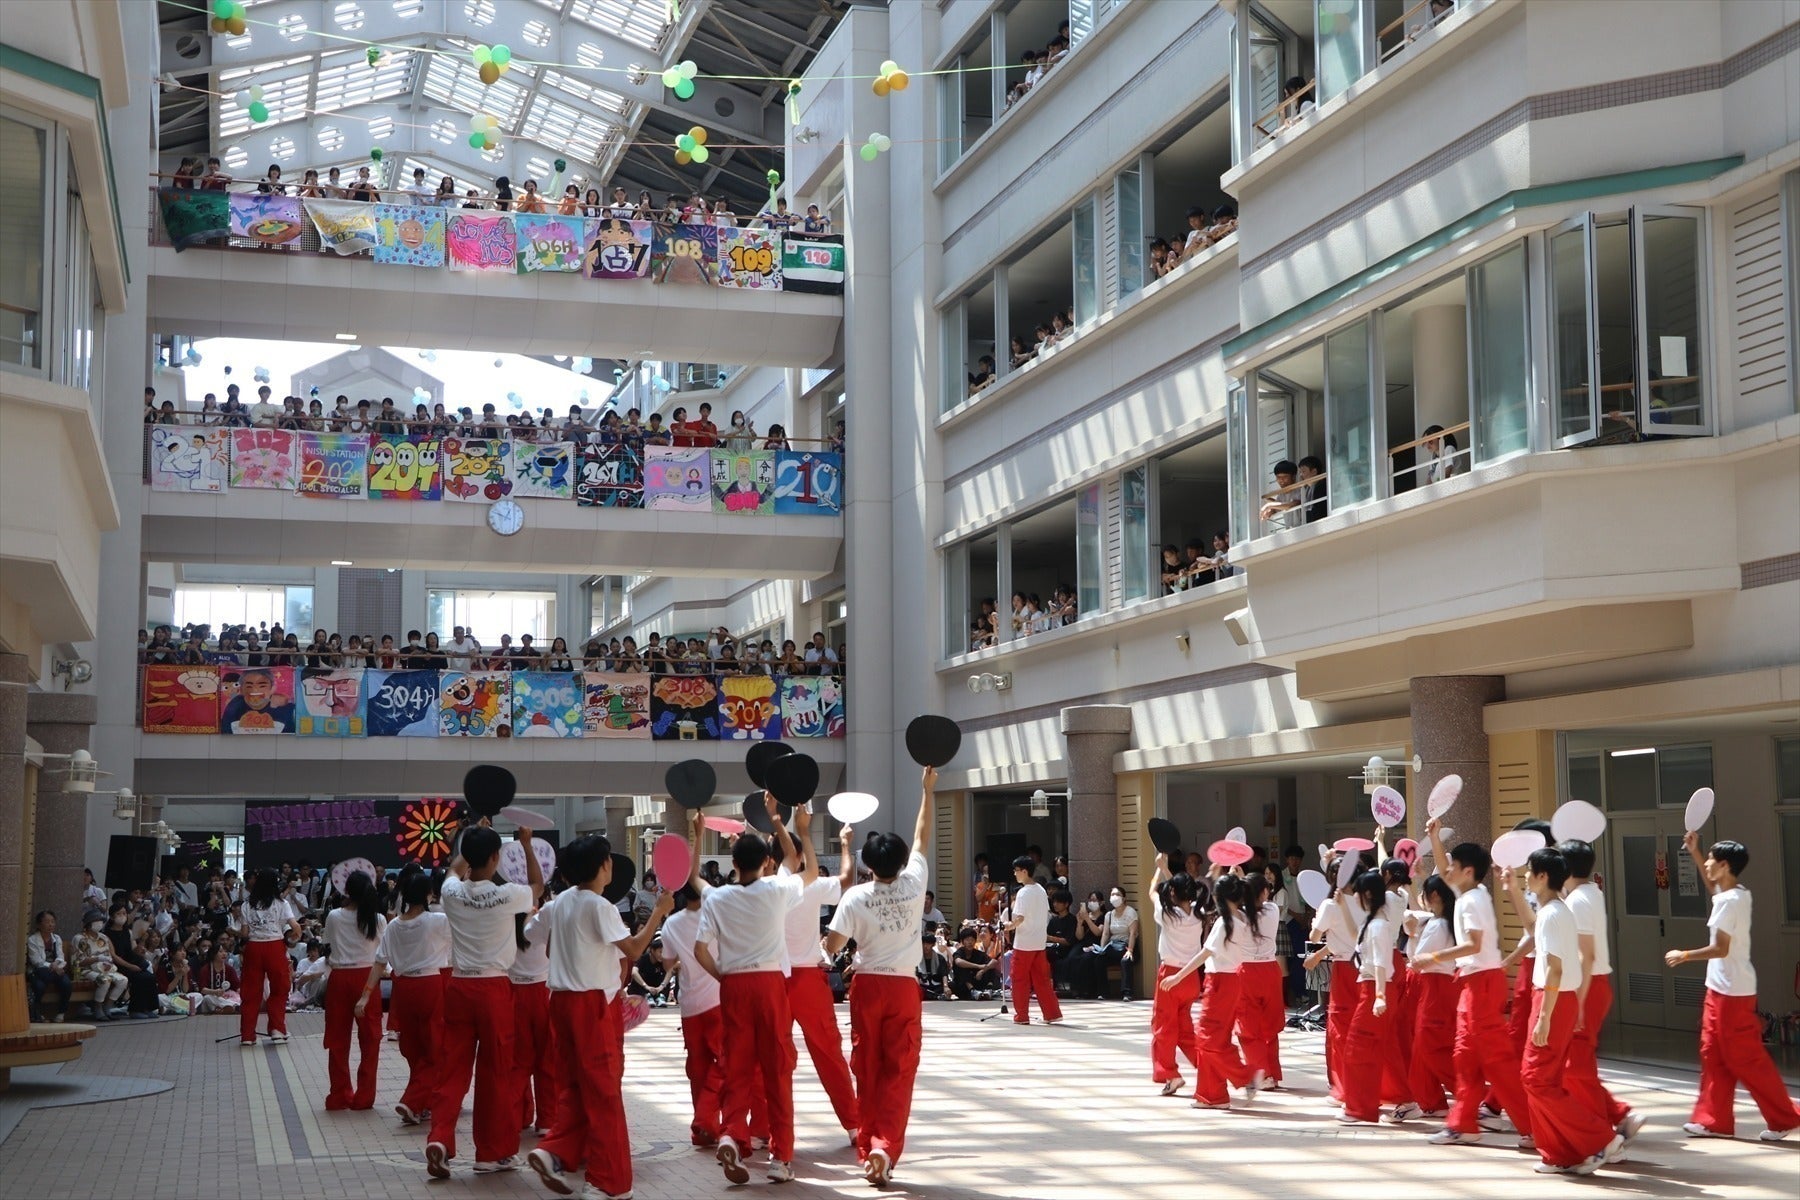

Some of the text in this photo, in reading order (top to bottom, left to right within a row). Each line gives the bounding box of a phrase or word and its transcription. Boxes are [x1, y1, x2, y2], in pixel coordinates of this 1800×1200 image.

[531, 239, 573, 254] 106H
[665, 237, 703, 260] 108
[803, 249, 831, 265] 110
[728, 245, 773, 277] 109
[330, 448, 364, 459] STATION
[714, 460, 727, 481] 平成
[759, 460, 771, 483] 令和
[775, 459, 837, 505] 210
[664, 676, 705, 695] 308
[532, 687, 575, 710] 306
[440, 708, 485, 735] 305
[721, 702, 775, 728] 309
[795, 710, 819, 725] 310
